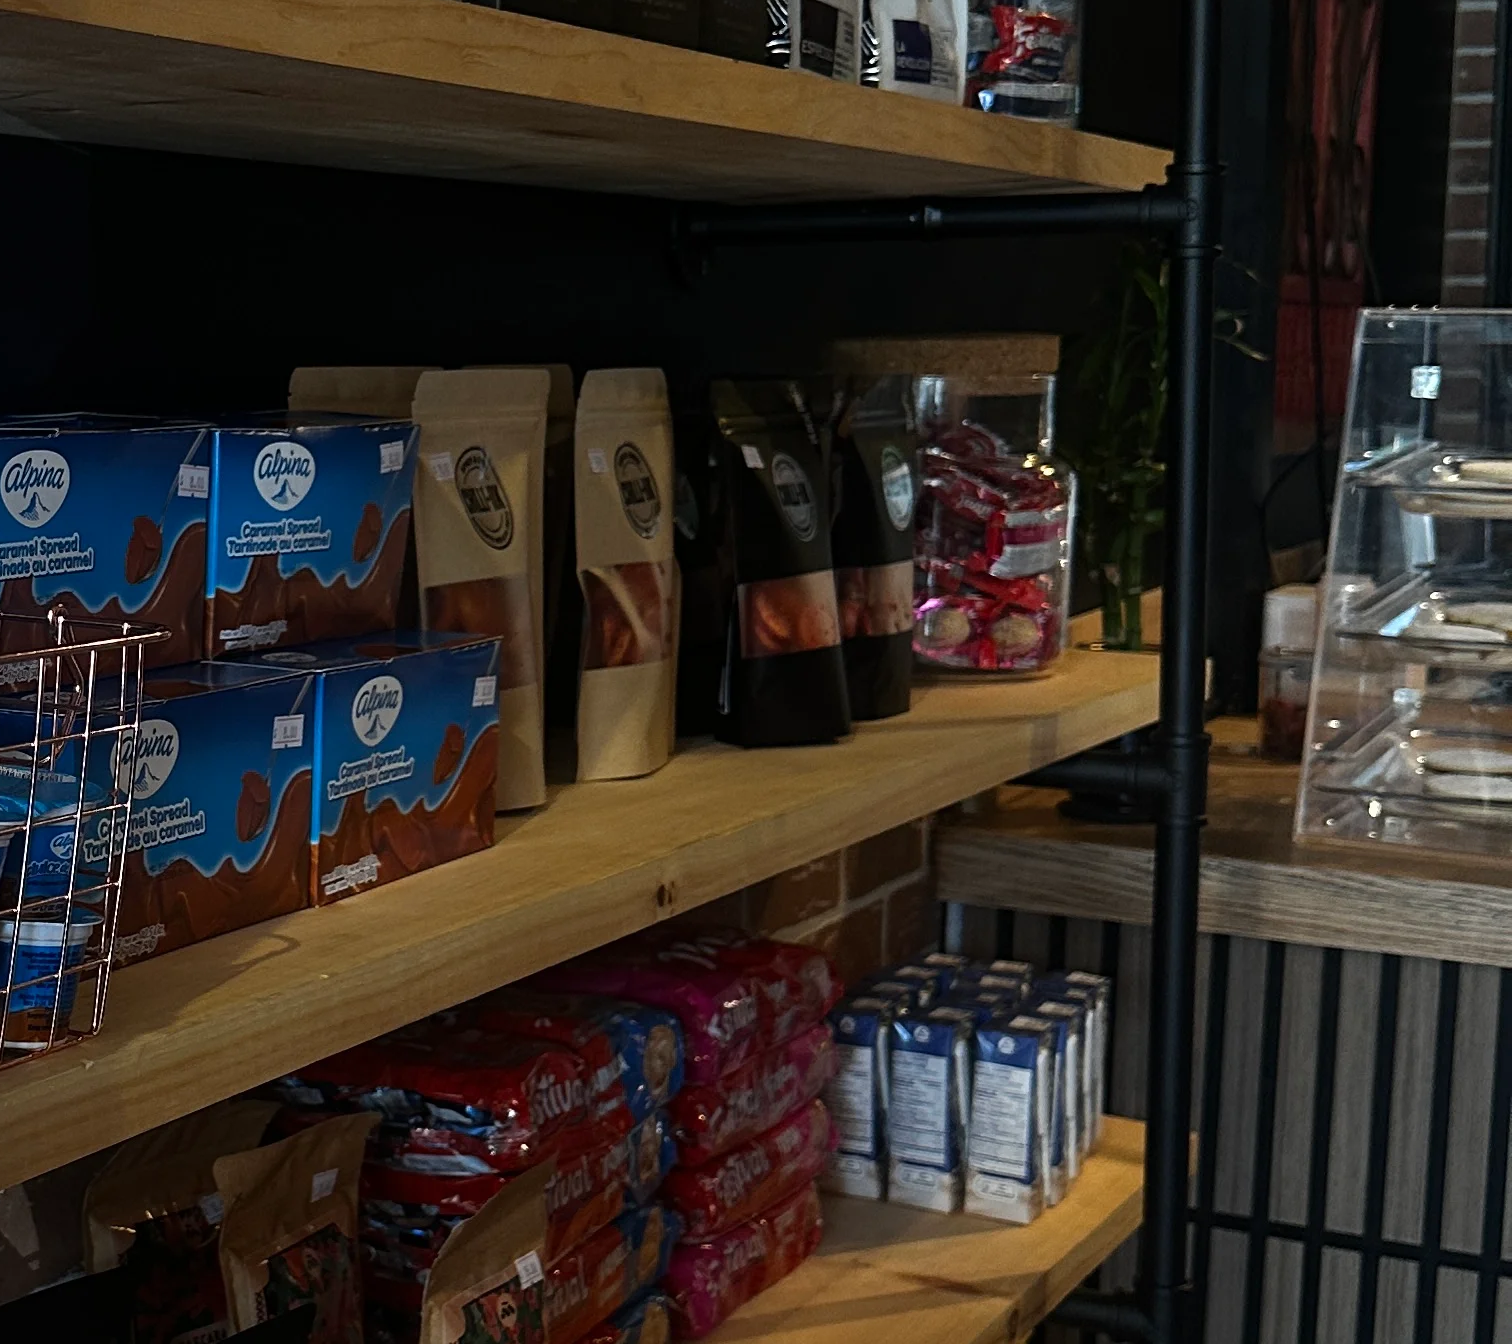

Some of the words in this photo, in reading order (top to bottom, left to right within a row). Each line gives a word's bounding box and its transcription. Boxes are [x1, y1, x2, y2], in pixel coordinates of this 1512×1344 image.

[242, 522, 286, 537] Caramel
[287, 518, 321, 534] Spread
[40, 533, 80, 557] Spread
[228, 537, 278, 554] Tartinade
[279, 539, 292, 550] au
[293, 533, 330, 549] caramel
[31, 562, 46, 575] au
[48, 550, 93, 573] caramel
[149, 799, 189, 824] Spread
[143, 831, 158, 846] au
[159, 811, 205, 842] caramel
